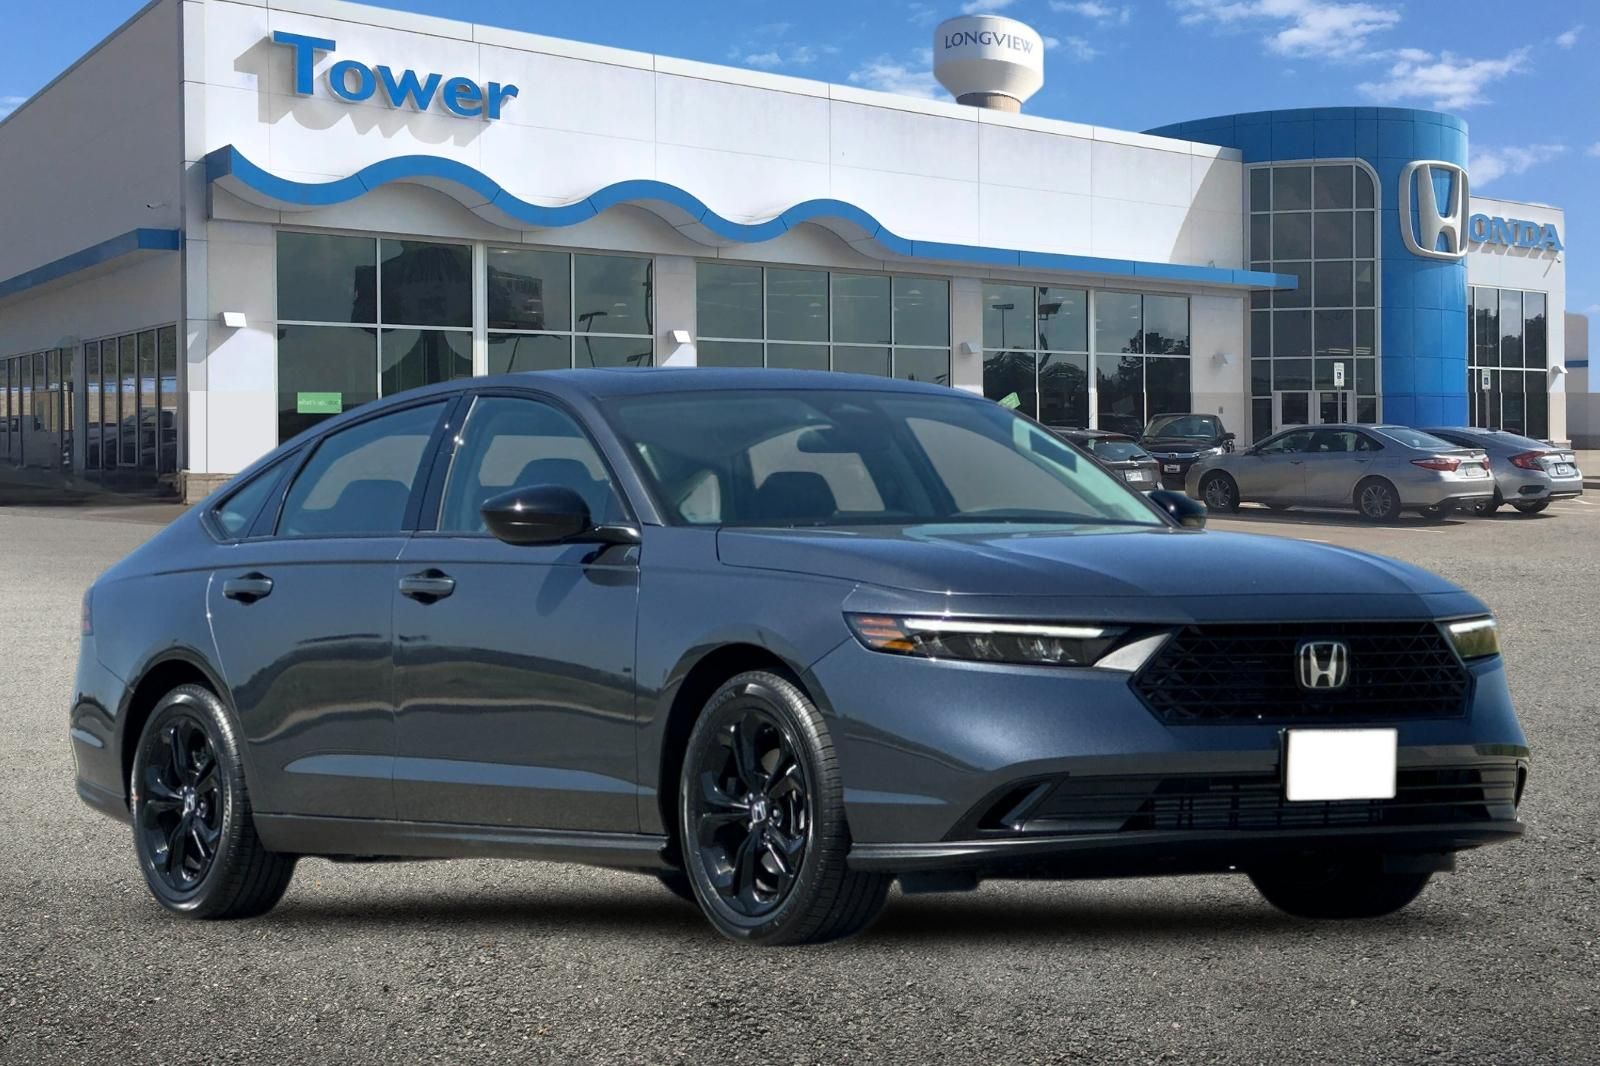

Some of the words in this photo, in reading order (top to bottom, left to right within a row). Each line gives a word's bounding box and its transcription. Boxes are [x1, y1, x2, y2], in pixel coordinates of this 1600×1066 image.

[945, 31, 1034, 55] LONGVIEW
[273, 30, 520, 121] Tower
[1469, 213, 1564, 250] ONDA
